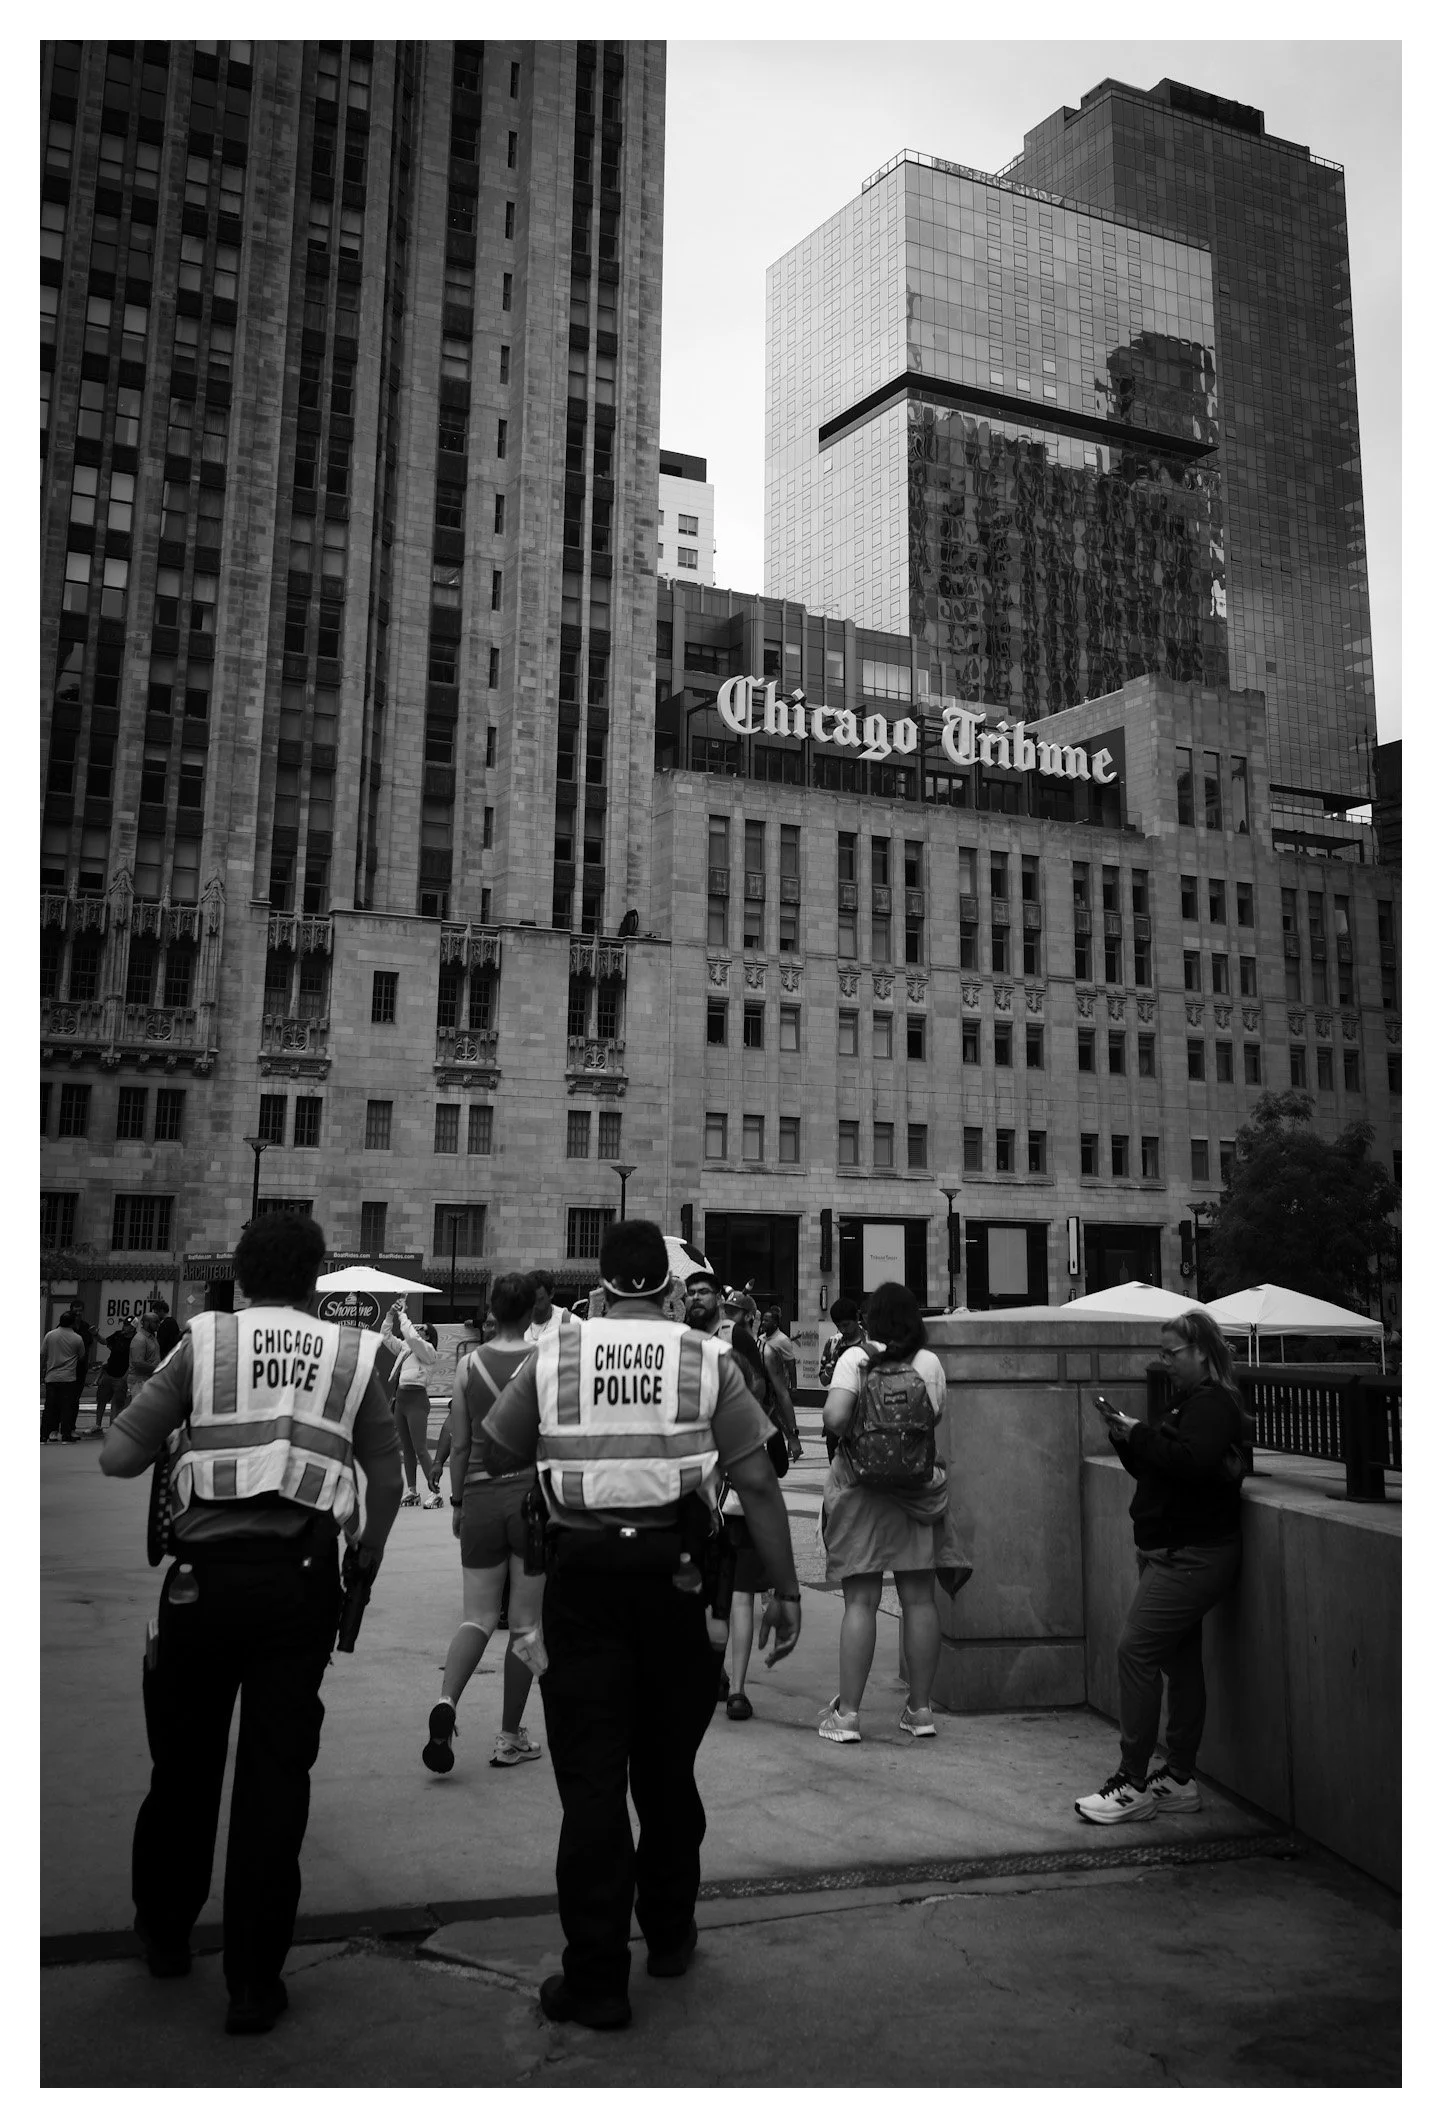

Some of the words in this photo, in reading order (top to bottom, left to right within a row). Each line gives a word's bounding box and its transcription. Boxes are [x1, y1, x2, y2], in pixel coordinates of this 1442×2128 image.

[717, 675, 918, 761] Chicago
[942, 706, 1137, 784] Tribune
[183, 1263, 237, 1280] ARCHITECTU
[107, 1299, 130, 1317] BIG
[134, 1299, 164, 1317] CIT
[325, 1301, 373, 1317] Shoreine
[253, 1329, 323, 1359] CHICAGO
[595, 1343, 664, 1371] CHICAGO
[253, 1358, 319, 1392] POLICE
[594, 1374, 662, 1405] POLICE
